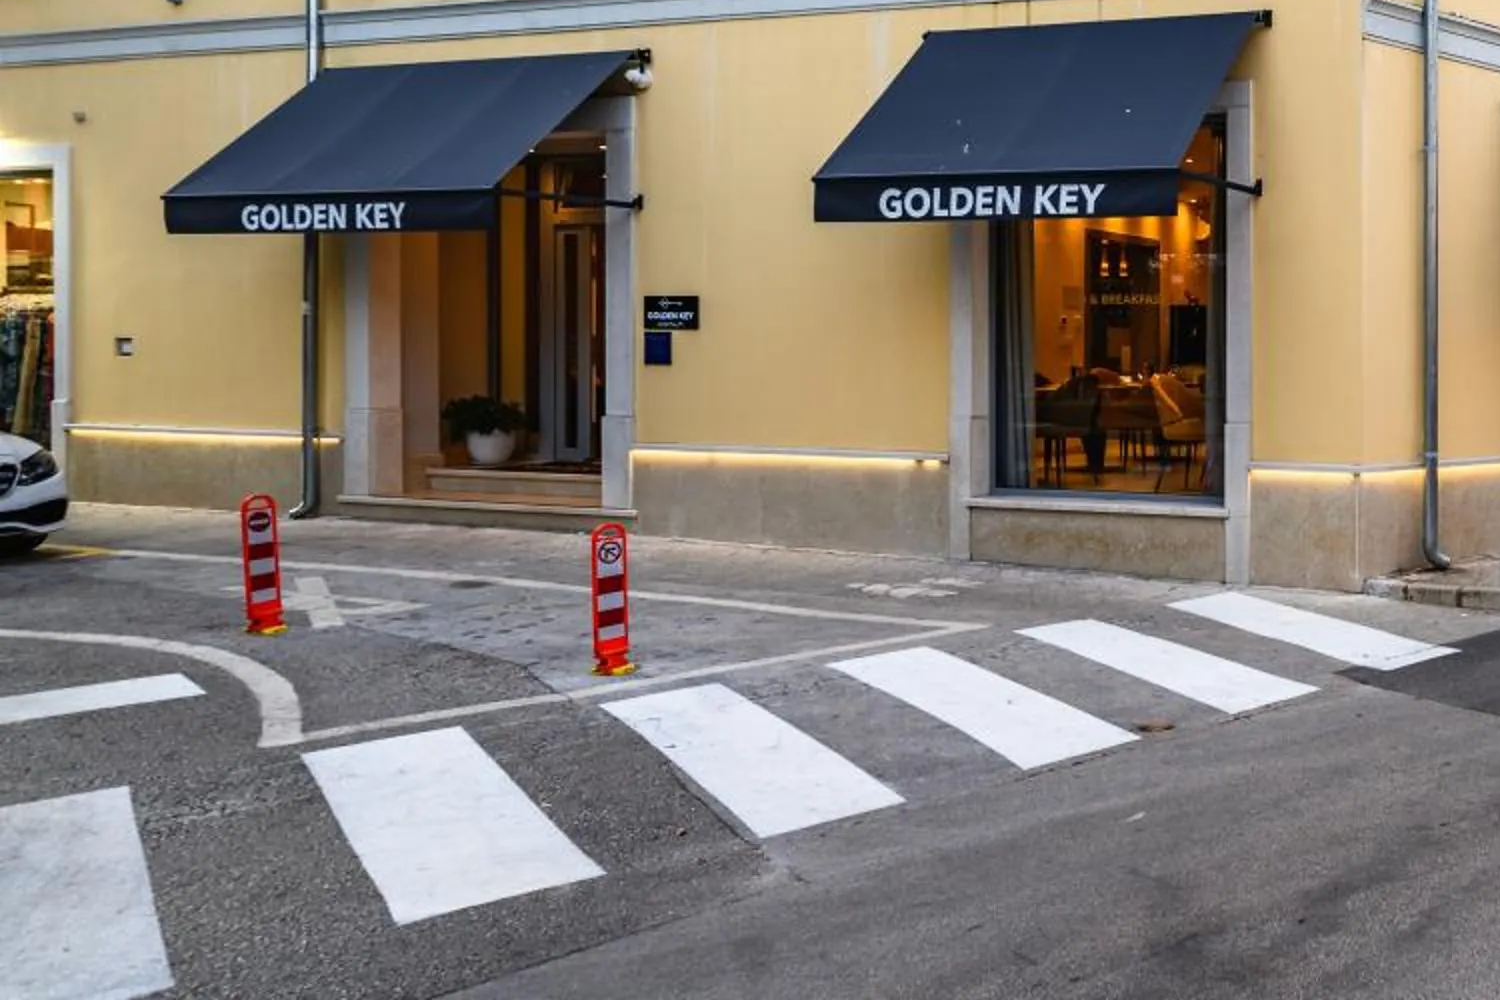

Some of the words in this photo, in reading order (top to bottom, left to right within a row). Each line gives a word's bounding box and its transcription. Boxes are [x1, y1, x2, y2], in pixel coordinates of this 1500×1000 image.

[241, 203, 347, 231] GOLDEN
[355, 202, 405, 230] KEY
[879, 185, 1022, 218] GOLDEN
[1033, 183, 1106, 215] KEY
